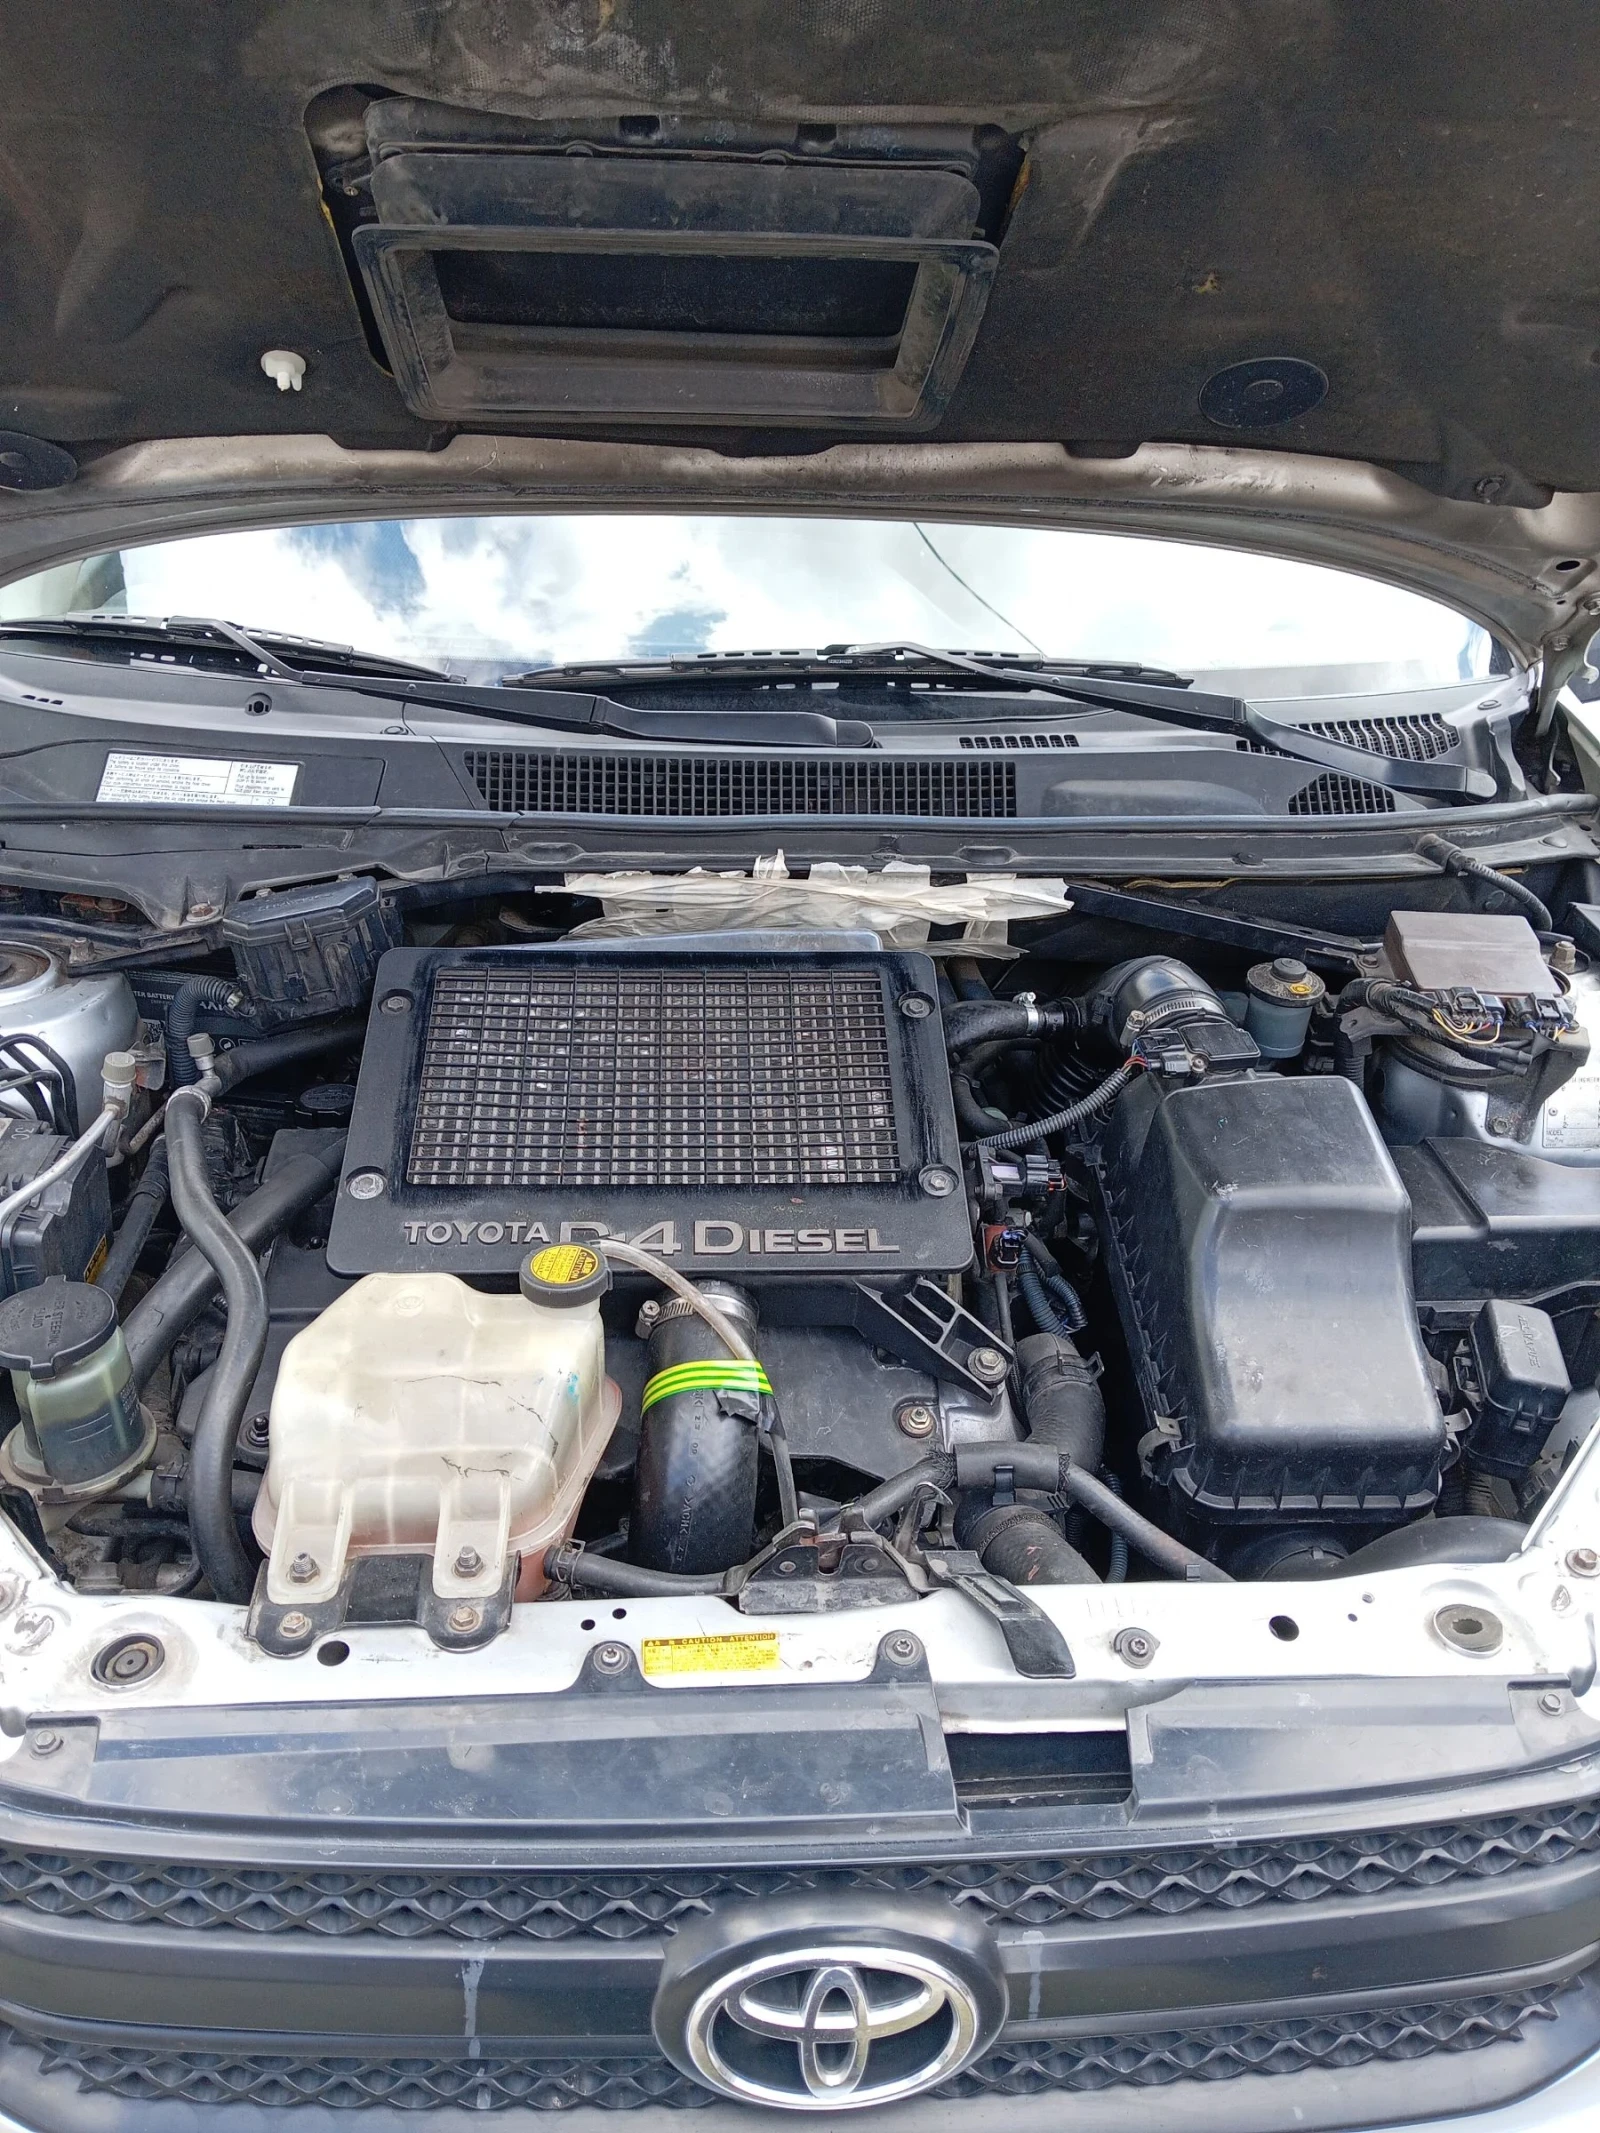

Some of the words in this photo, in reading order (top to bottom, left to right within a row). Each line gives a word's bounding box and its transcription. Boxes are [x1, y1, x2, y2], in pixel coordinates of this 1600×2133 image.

[147, 992, 175, 1001] BATTERY
[404, 1221, 550, 1244] TOYOTA
[694, 1220, 901, 1255] DIESEL
[571, 1251, 588, 1279] CAUTION
[681, 1637, 723, 1645] CAUTION
[729, 1633, 774, 1642] ATTENTION
